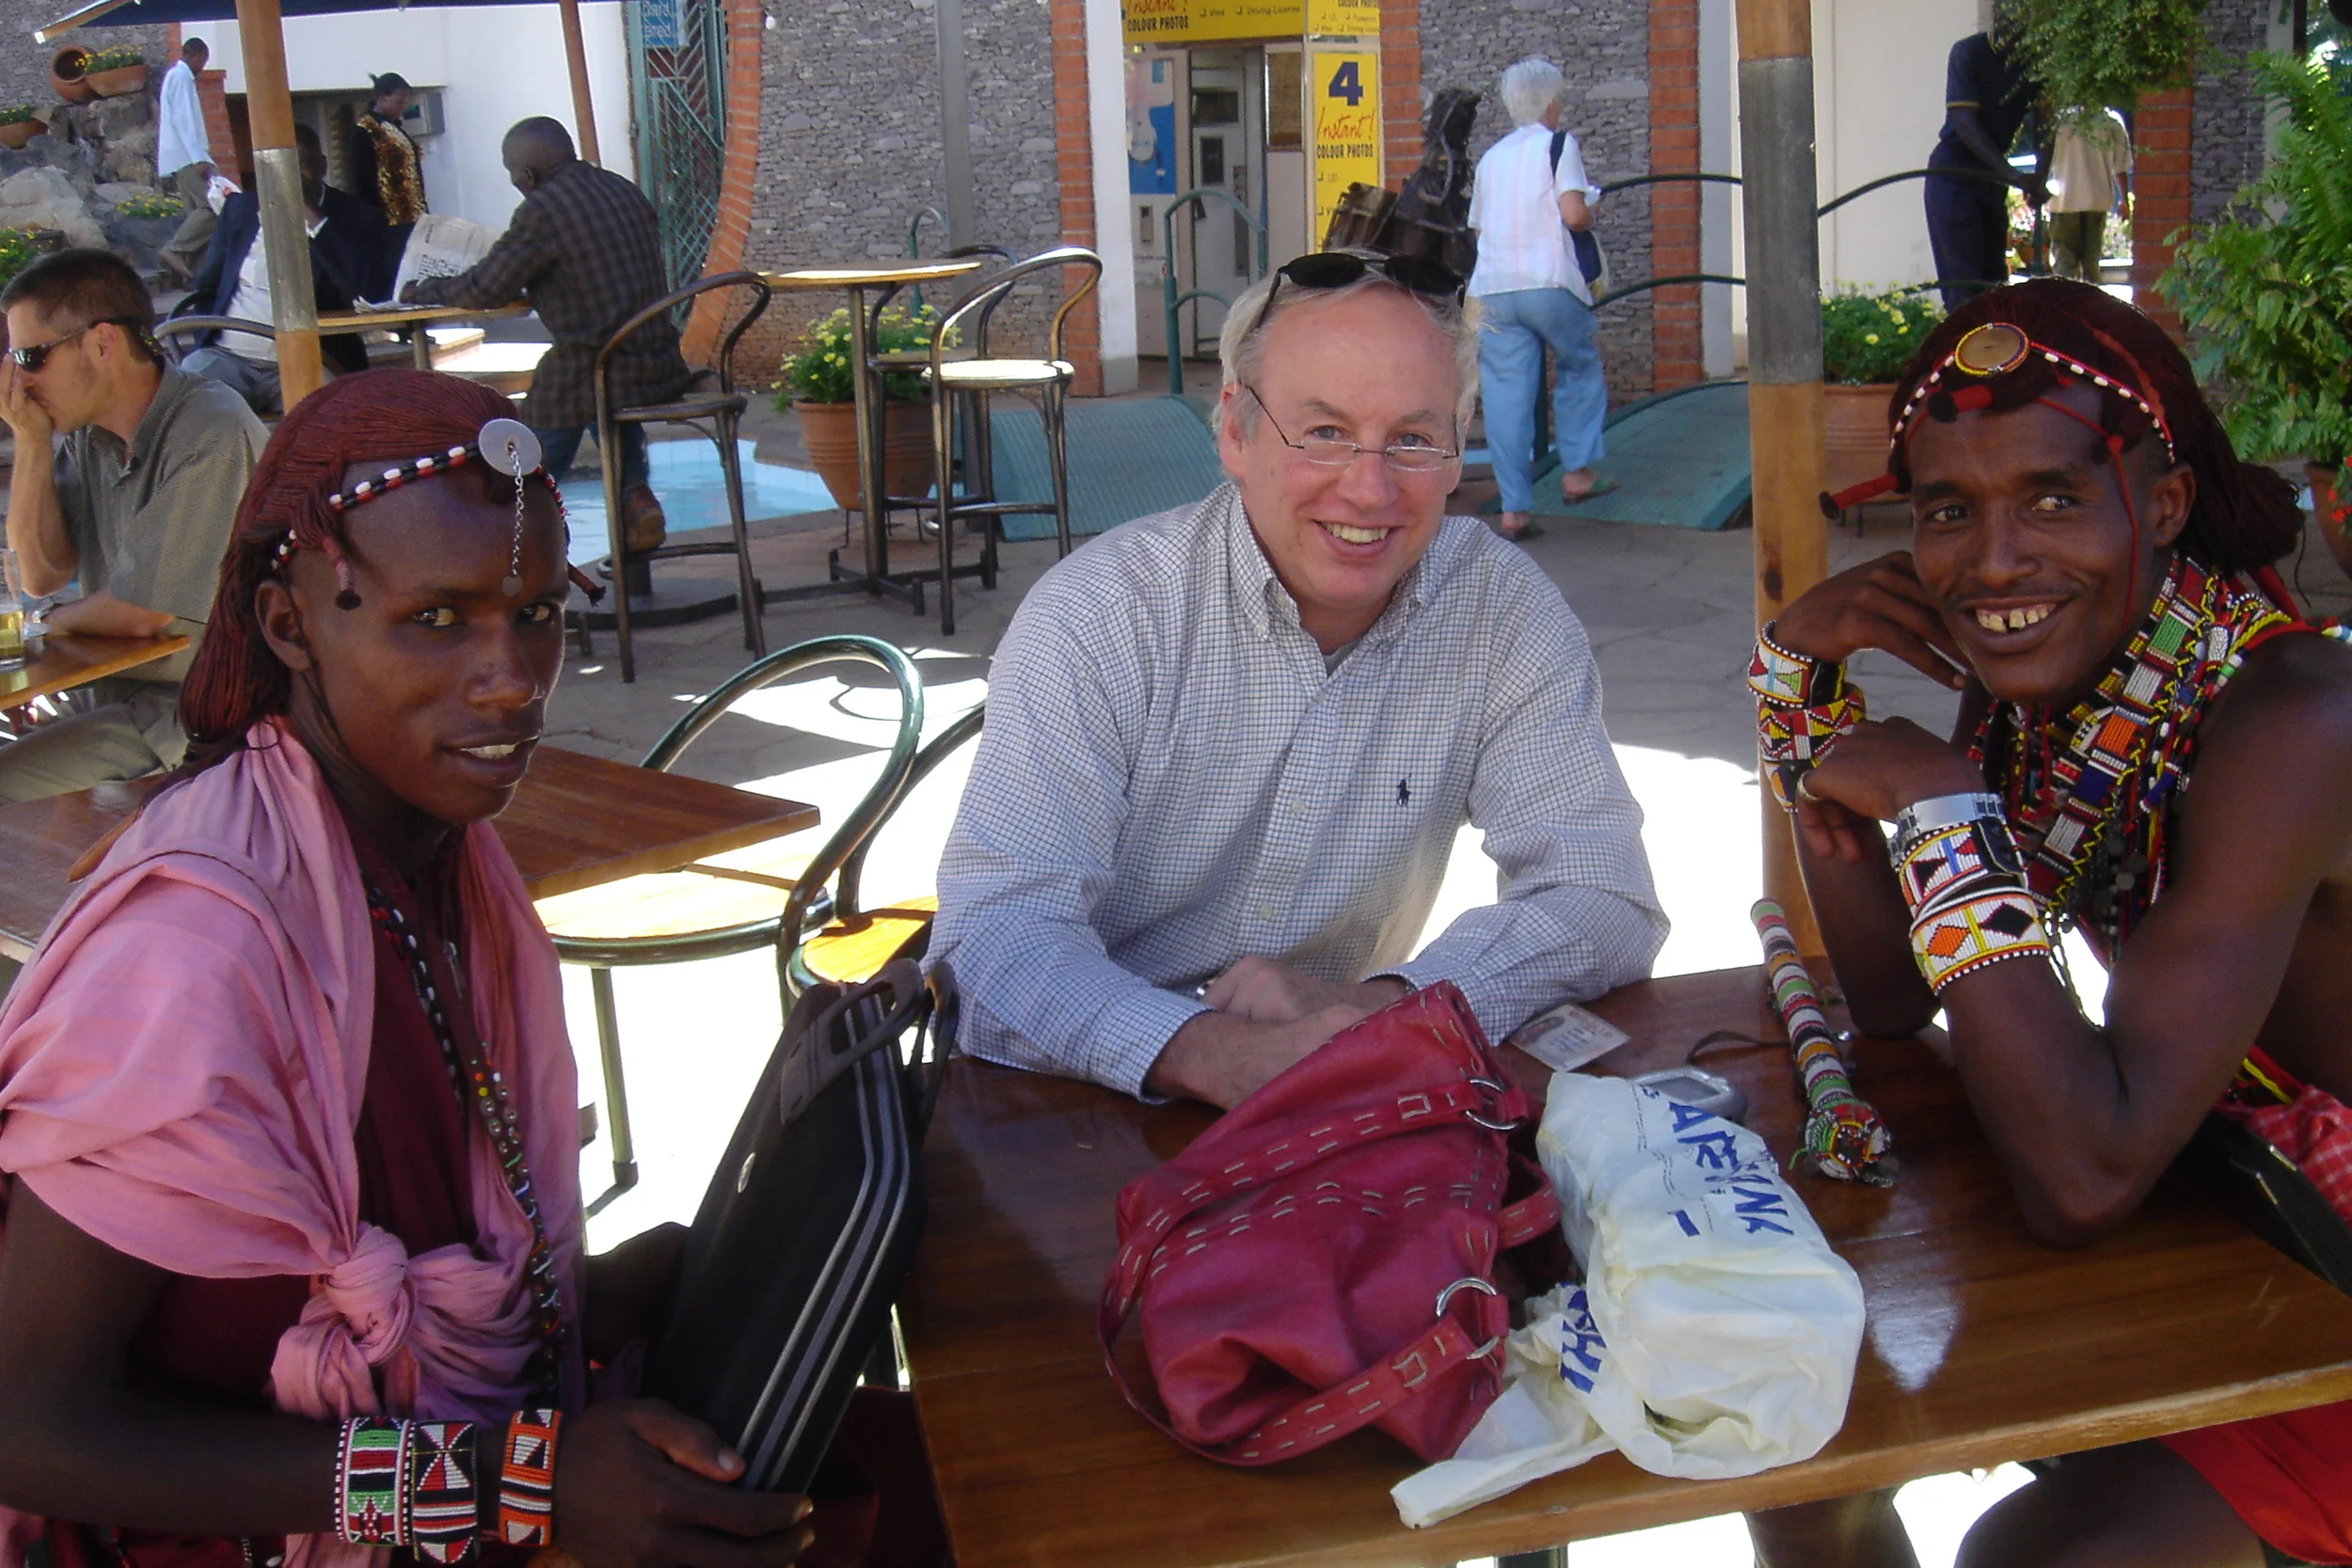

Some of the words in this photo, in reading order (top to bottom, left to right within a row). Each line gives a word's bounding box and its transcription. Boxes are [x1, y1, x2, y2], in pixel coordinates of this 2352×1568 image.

[1128, 18, 1157, 32] COLOUR
[1159, 15, 1189, 29] PHOTOS
[1328, 61, 1363, 106] 4
[1317, 144, 1343, 159] COLOUR
[1347, 143, 1373, 158] PHOTOS
